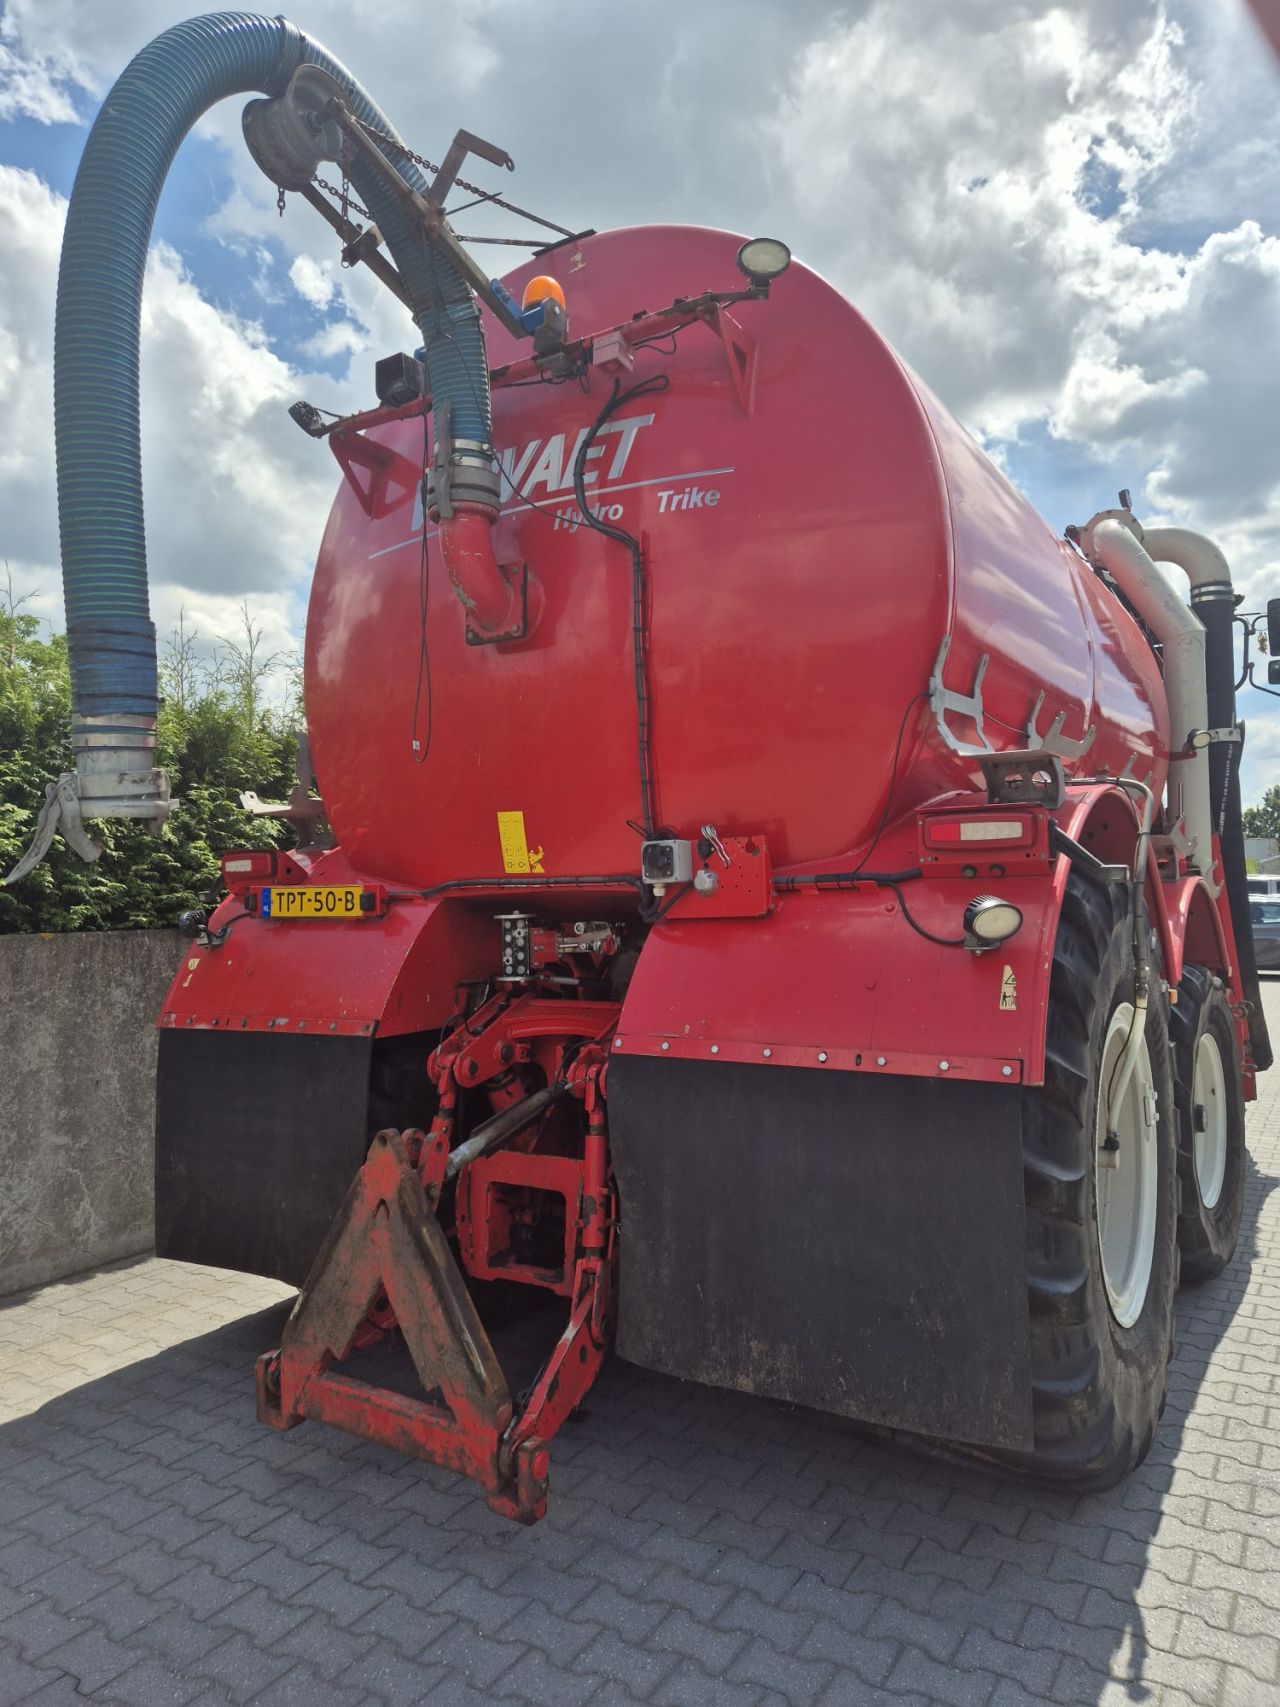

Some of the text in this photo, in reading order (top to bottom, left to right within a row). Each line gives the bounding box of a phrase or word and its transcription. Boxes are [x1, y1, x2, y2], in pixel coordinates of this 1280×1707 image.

[411, 413, 656, 532] VAET
[657, 486, 720, 513] Trike
[276, 891, 355, 912] TPT-50-B
